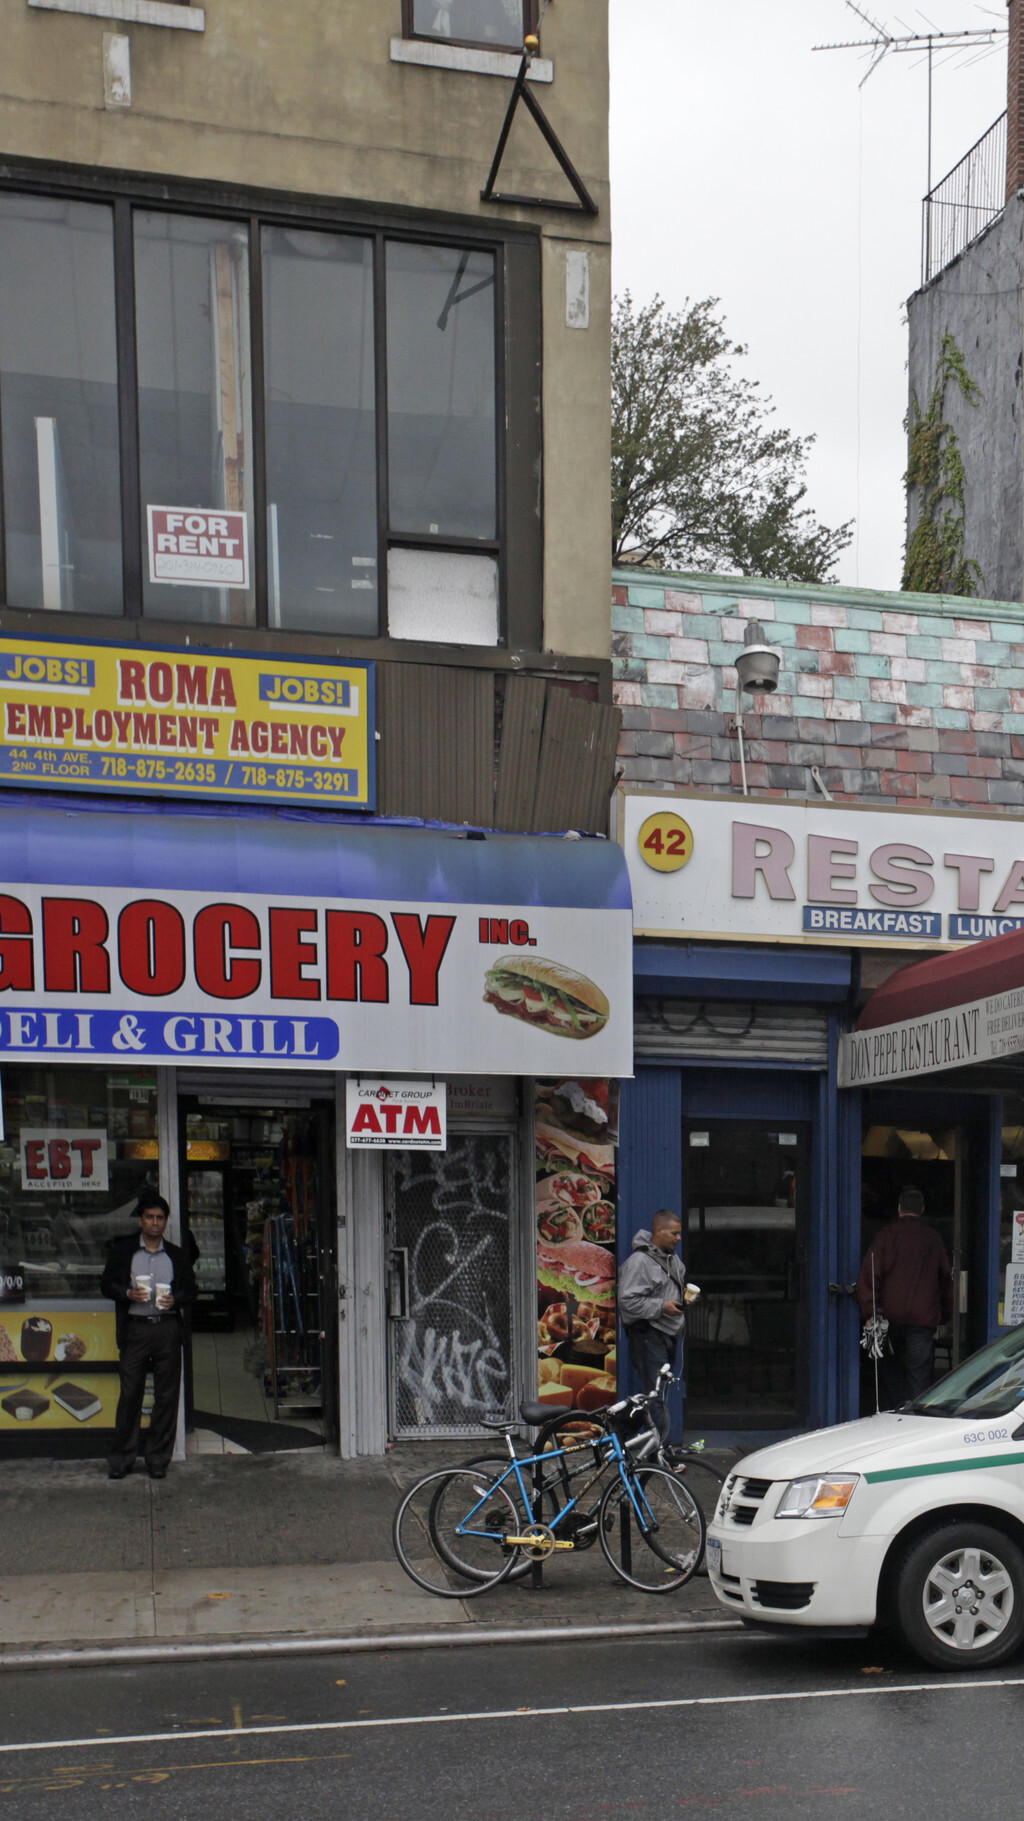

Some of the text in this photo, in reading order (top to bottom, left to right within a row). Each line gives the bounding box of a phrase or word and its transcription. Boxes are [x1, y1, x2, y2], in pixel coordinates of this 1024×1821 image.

[166, 513, 229, 536] FOR
[157, 533, 240, 557] RENT
[6, 656, 88, 685] JOBS!
[118, 659, 237, 712] ROMA
[266, 676, 344, 705] JOBS!
[5, 702, 346, 761] EMPLOYMENT AGENCY
[9, 748, 92, 764] 44 4th AVE.
[12, 760, 91, 776] 2ND FLOOR
[101, 756, 216, 783] 718-875-2635
[241, 765, 349, 792] 718-875-3291
[643, 827, 687, 856] 42
[478, 916, 537, 946] INC.
[810, 909, 935, 934] BREAKFAST
[0, 1010, 319, 1056] ELI & GRILL
[850, 1007, 980, 1081] DON PEPE RESTAURANT
[401, 1090, 433, 1099] GROUP
[351, 1103, 442, 1135] ATM
[25, 1138, 102, 1180] EBT
[963, 1428, 1009, 1444] 63C 002
